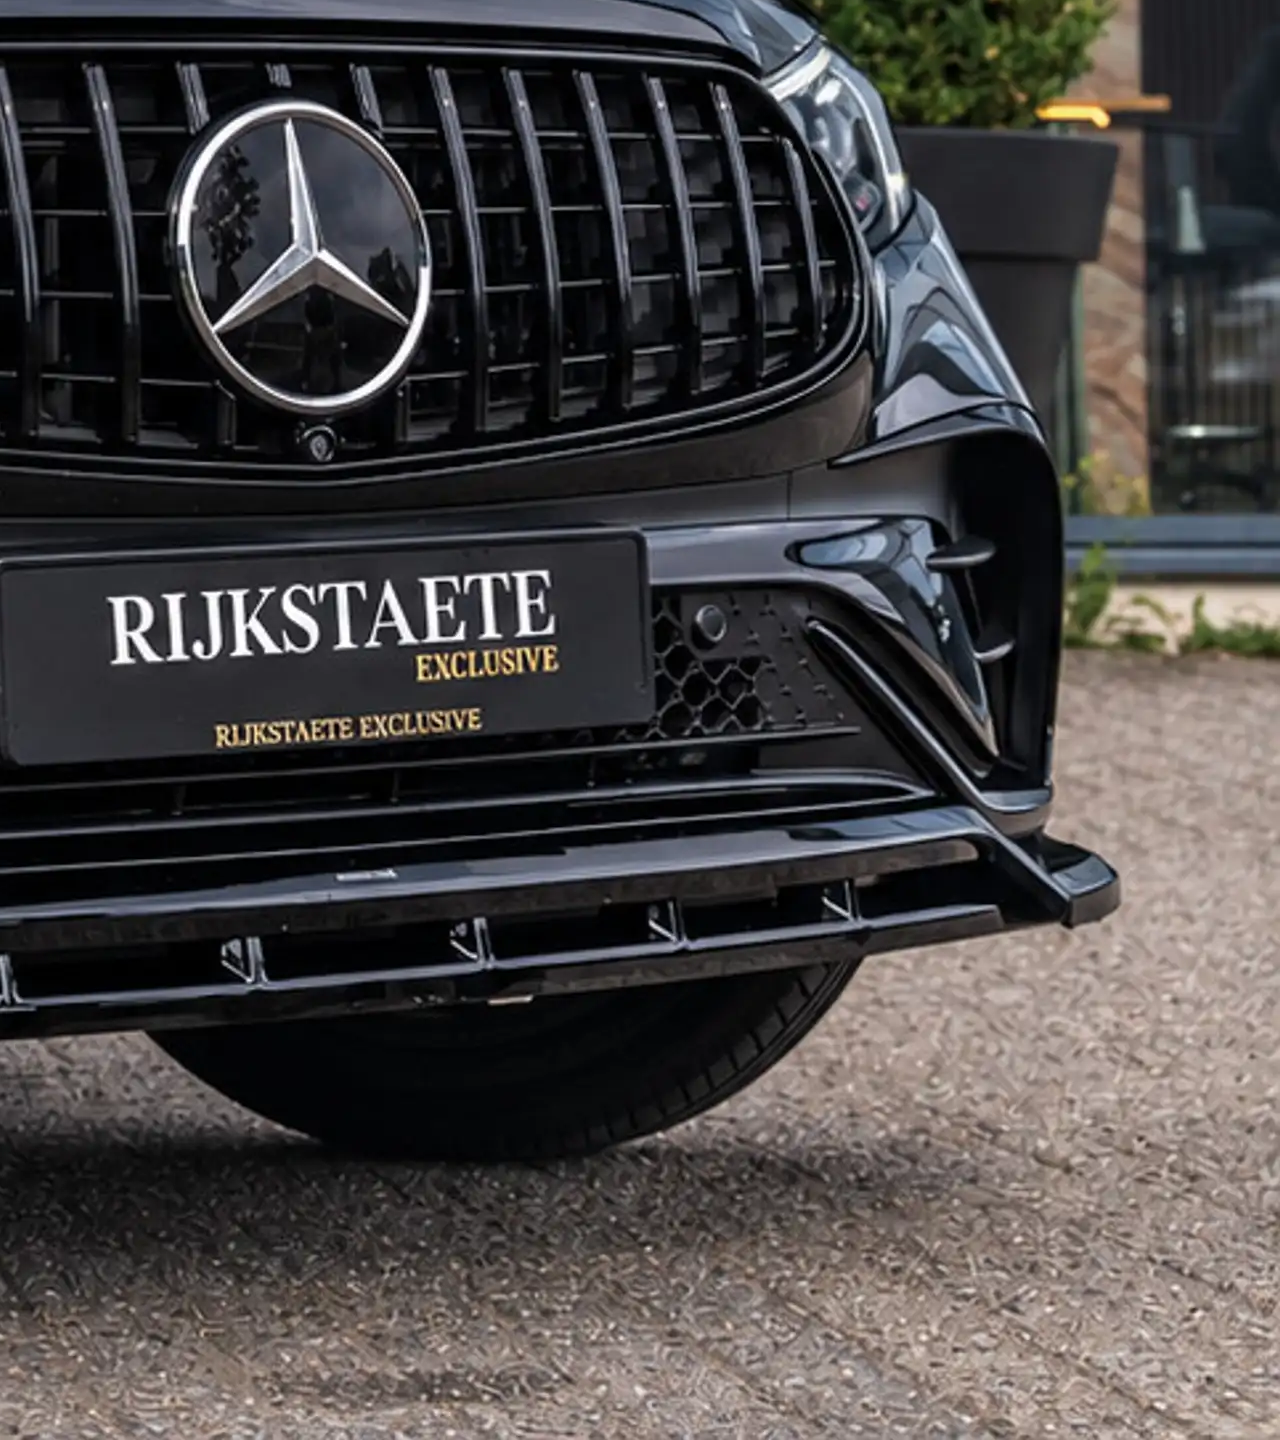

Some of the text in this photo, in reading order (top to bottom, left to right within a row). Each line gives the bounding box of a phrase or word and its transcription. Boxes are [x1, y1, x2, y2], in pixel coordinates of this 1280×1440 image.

[106, 569, 557, 666] RIJKSTAETE
[415, 644, 559, 683] EXCLUSIVE
[214, 707, 482, 749] RIJKSTAETE EXCLUSIVE
